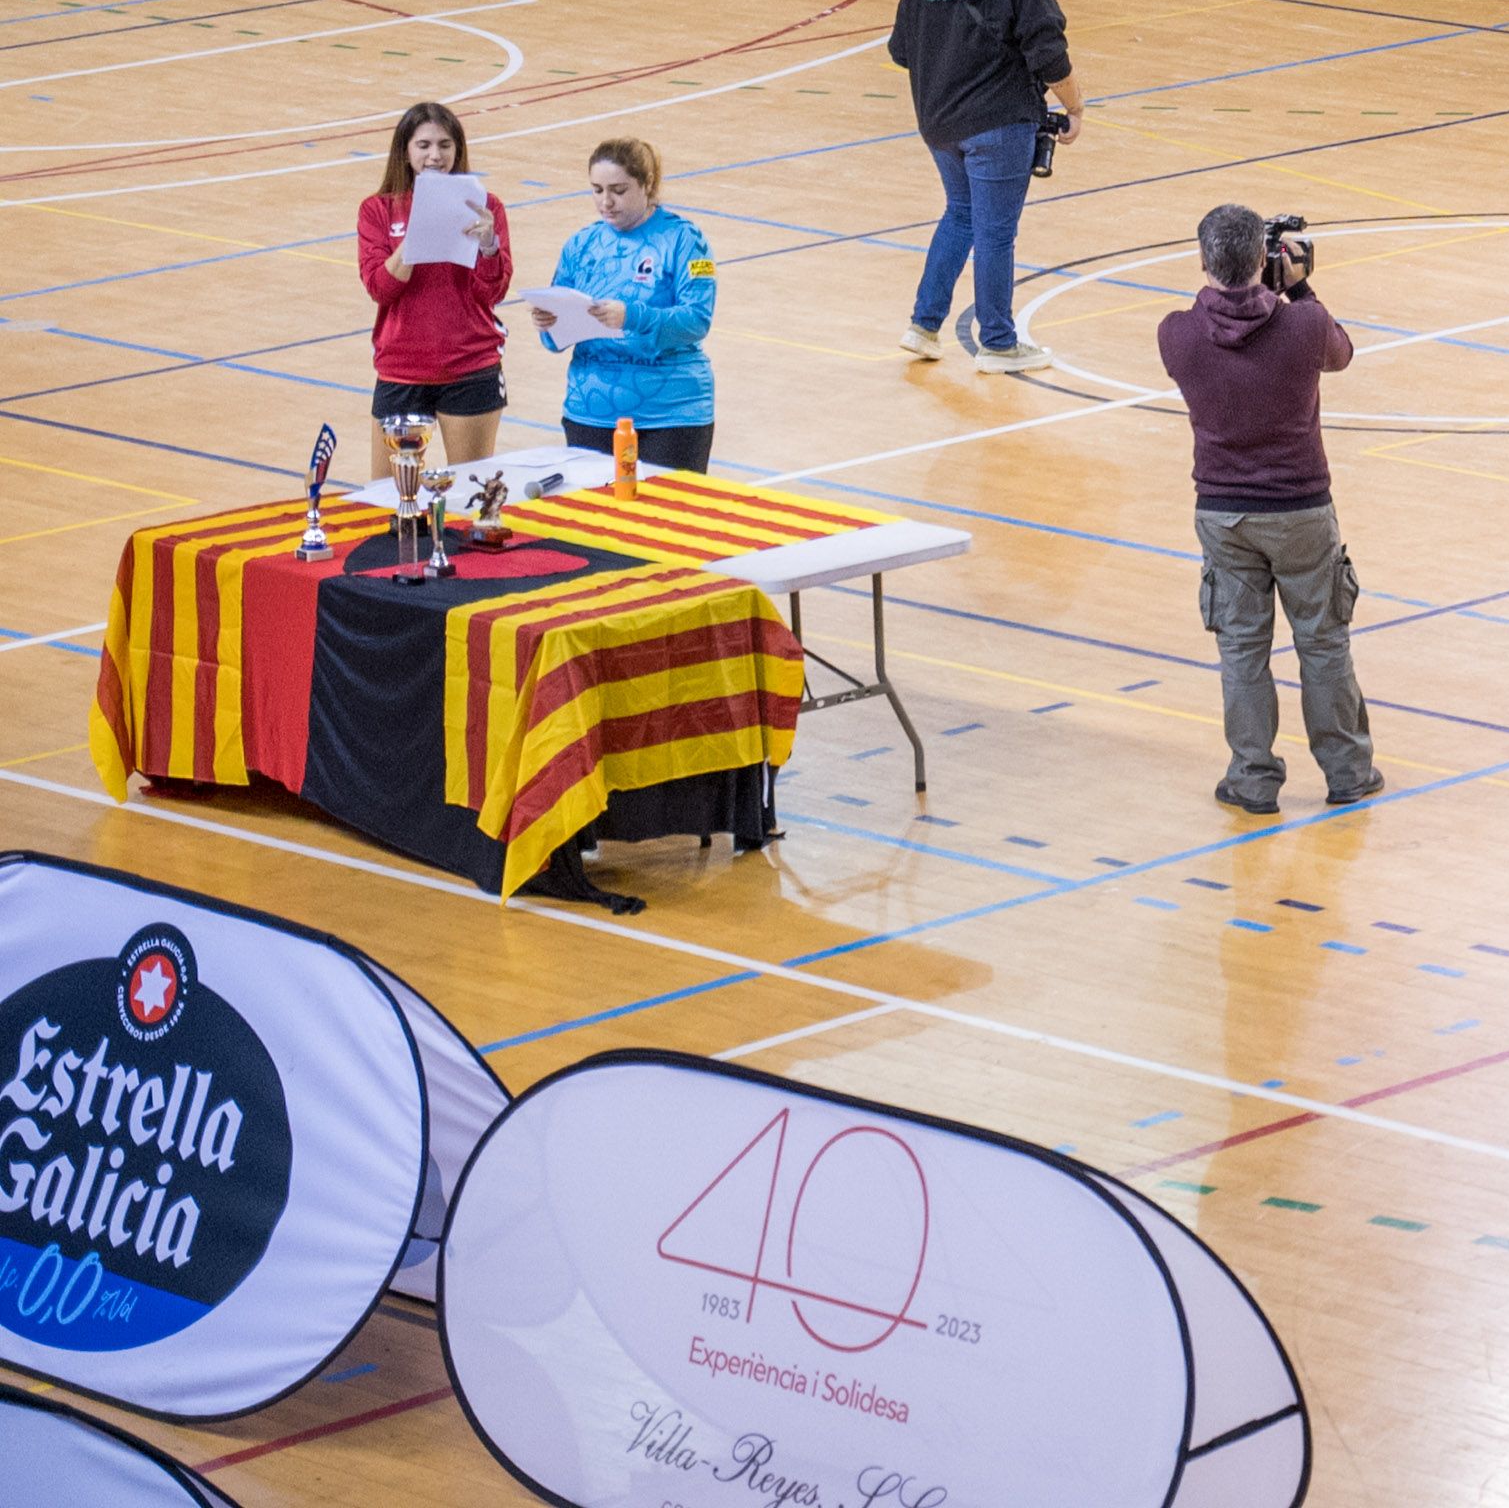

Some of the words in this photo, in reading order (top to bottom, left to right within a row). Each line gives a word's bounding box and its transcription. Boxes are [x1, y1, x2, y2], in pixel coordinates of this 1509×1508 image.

[127, 937, 160, 967] ESTRELLA
[160, 937, 185, 966] GALICIA
[117, 986, 143, 1041] CERVECEROS
[144, 1023, 169, 1042] DESDE
[0, 1016, 244, 1174] Estrella
[0, 1116, 200, 1269] Galicia
[656, 1107, 929, 1354] 40
[701, 1292, 741, 1321] 1983
[934, 1314, 983, 1345] 2023
[688, 1335, 808, 1396] Experiència
[811, 1370, 821, 1398] i
[821, 1372, 911, 1424] Solidesa
